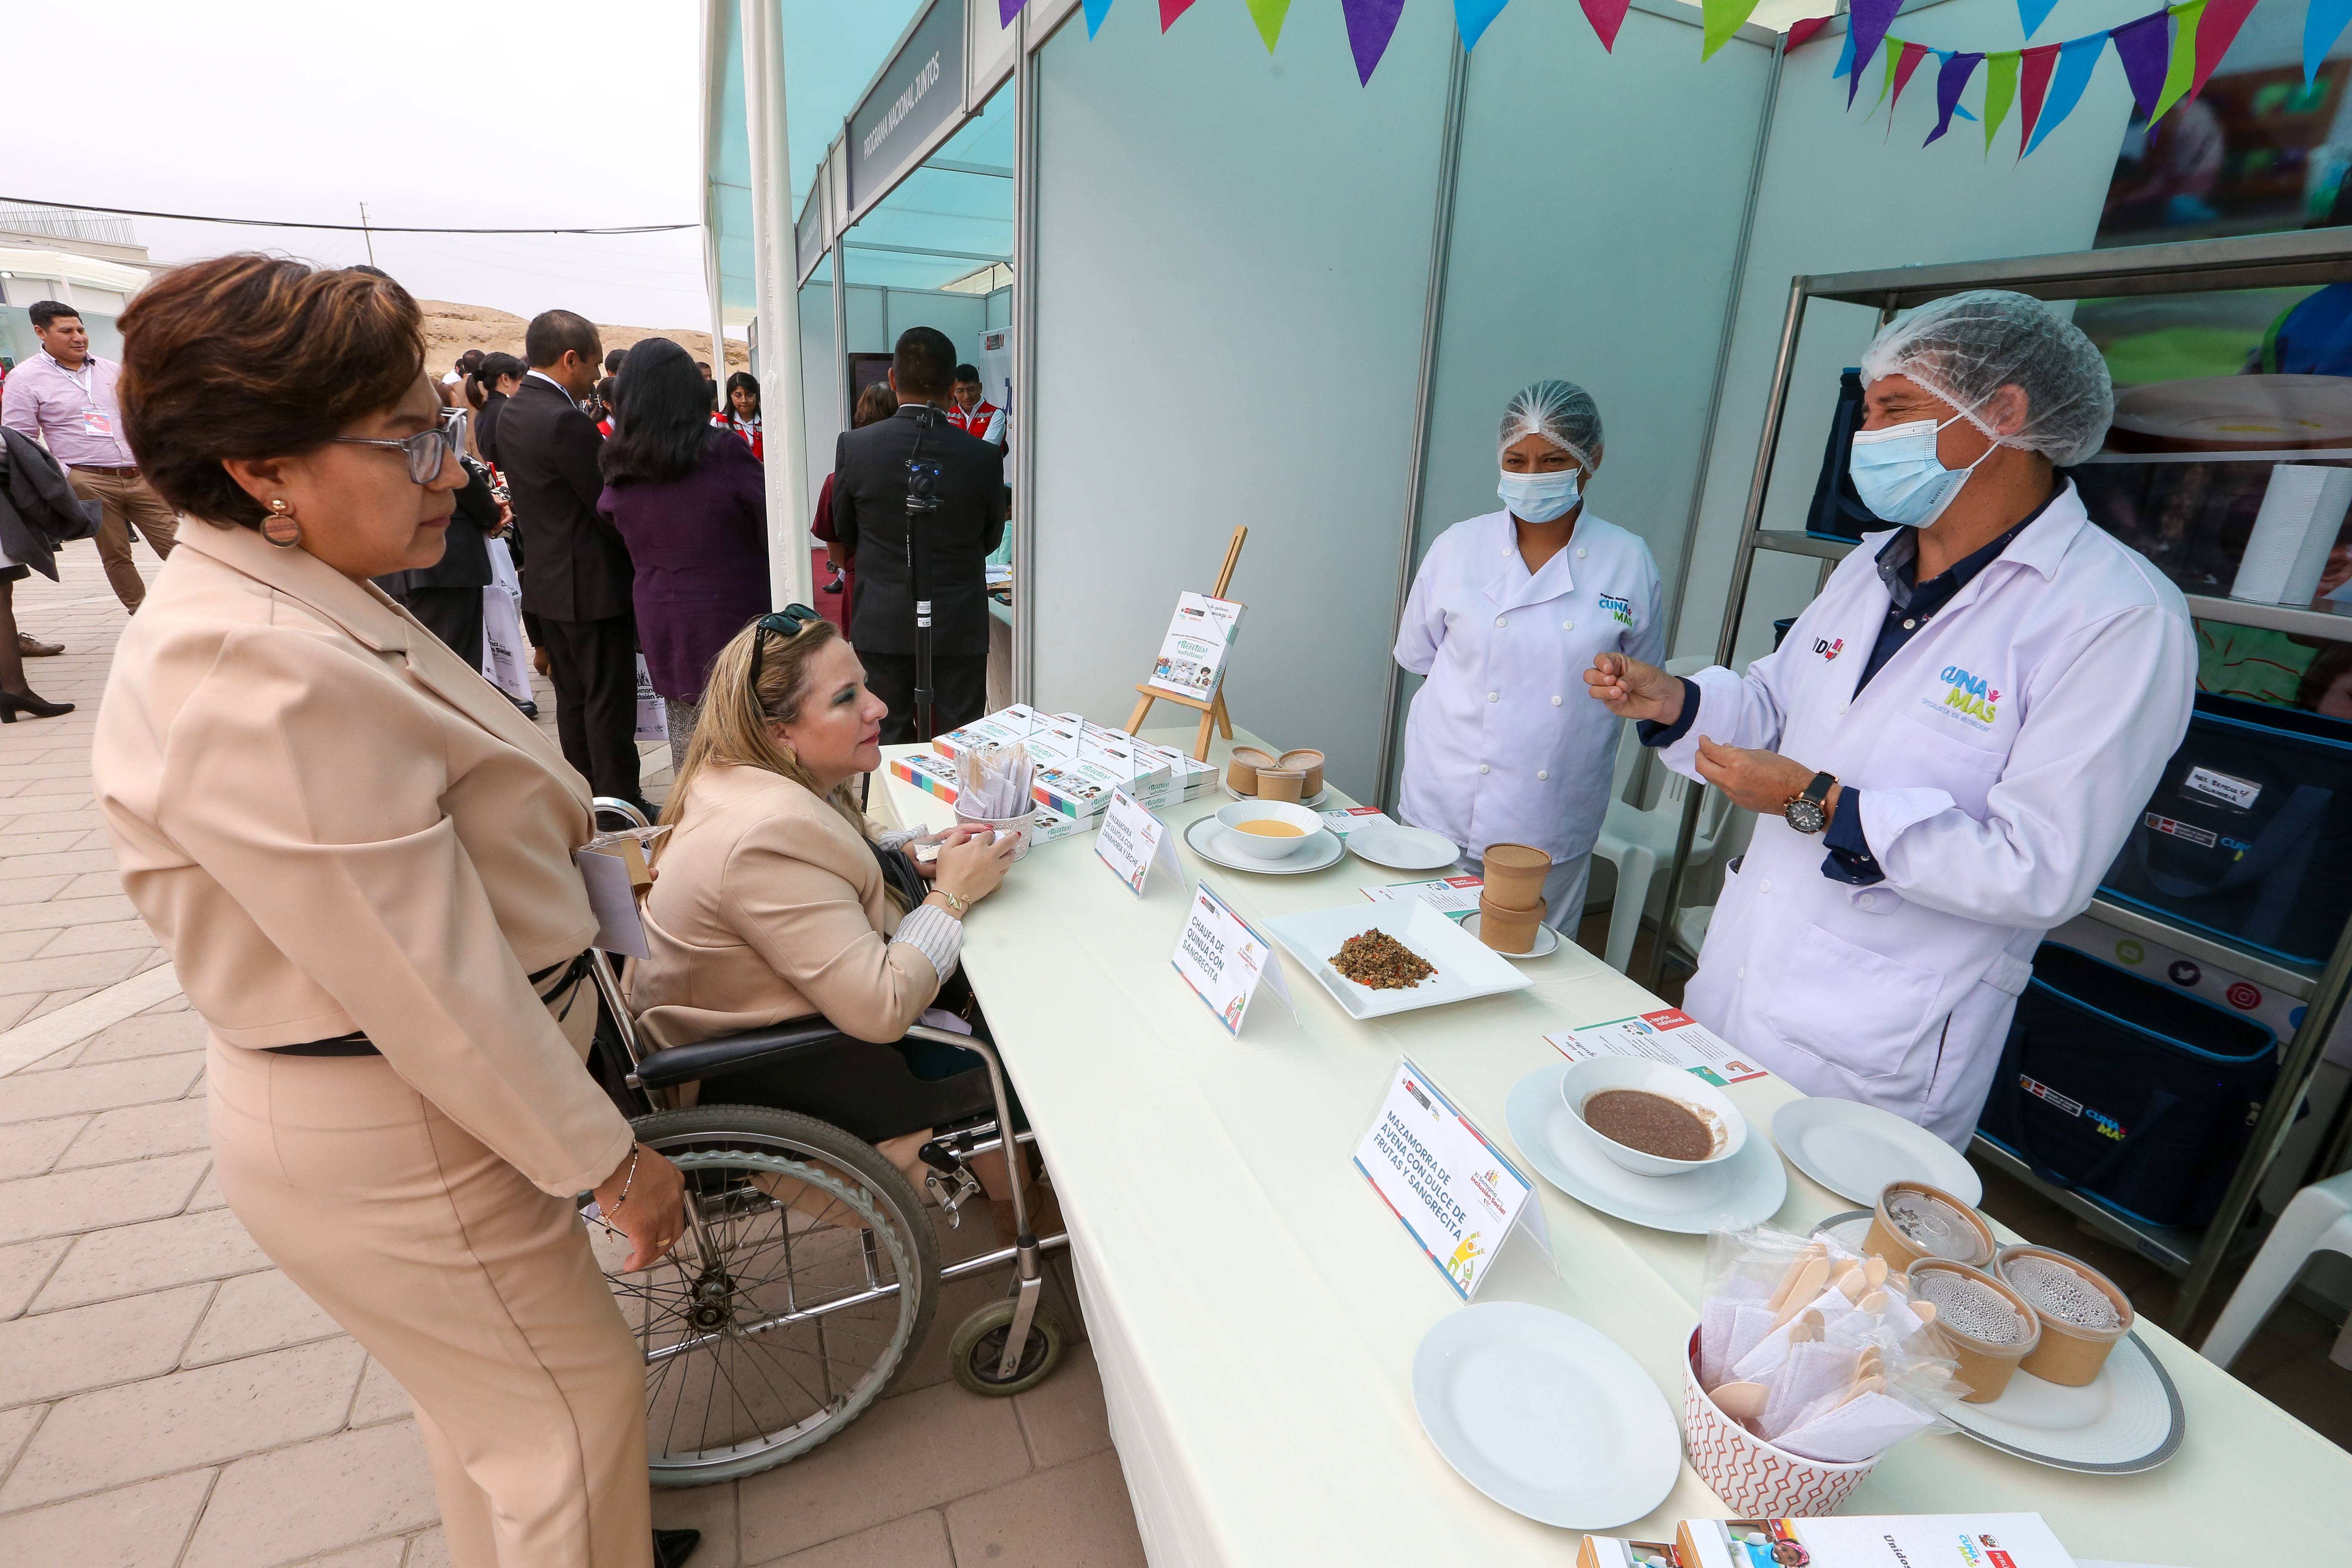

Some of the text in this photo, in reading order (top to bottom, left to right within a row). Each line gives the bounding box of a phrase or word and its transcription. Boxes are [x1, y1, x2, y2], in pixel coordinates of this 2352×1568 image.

[864, 51, 940, 160] PROGRAMA NACIONAL JUNTOS
[1599, 599, 1628, 614] CUNA
[1178, 649, 1203, 659] nutritivas
[1181, 640, 1205, 654] Recetas
[1941, 665, 1987, 700] CUNA
[986, 725, 1007, 737] Recetas
[1030, 745, 1053, 757] Recetas
[1076, 769, 1101, 781] nutritivas
[1083, 766, 1108, 779] Recetas
[1151, 783, 1168, 791] Recetas
[1148, 798, 1165, 806] Recetas
[1050, 826, 1070, 835] Recetas
[1106, 820, 1111, 829] DE
[1110, 824, 1124, 843] SEMOLA
[1124, 837, 1134, 851] CON
[1109, 812, 1132, 838] MAZAMORRA
[1102, 829, 1122, 854] ZANAHORIA
[1125, 851, 1139, 867] LECHE
[1192, 916, 1225, 955] CHAUFA DE
[1182, 939, 1218, 984] SANGRECITA
[1187, 928, 1225, 972] QUINUA CON
[1237, 950, 1258, 971] Inclusión Social
[1387, 1110, 1452, 1186] MAZAMORRA DE
[1381, 1123, 1467, 1225] AVENA CON DULCE DE
[1474, 1170, 1480, 1179] XI
[1479, 1176, 1498, 1198] Semana
[1373, 1133, 1462, 1242] FRUTAS Y SANGRECITA
[1470, 1175, 1491, 1200] Inclusión
[1491, 1197, 1507, 1216] Social
[1958, 1534, 1979, 1559] CUNA
[1994, 1552, 2009, 1568] PERÚ
